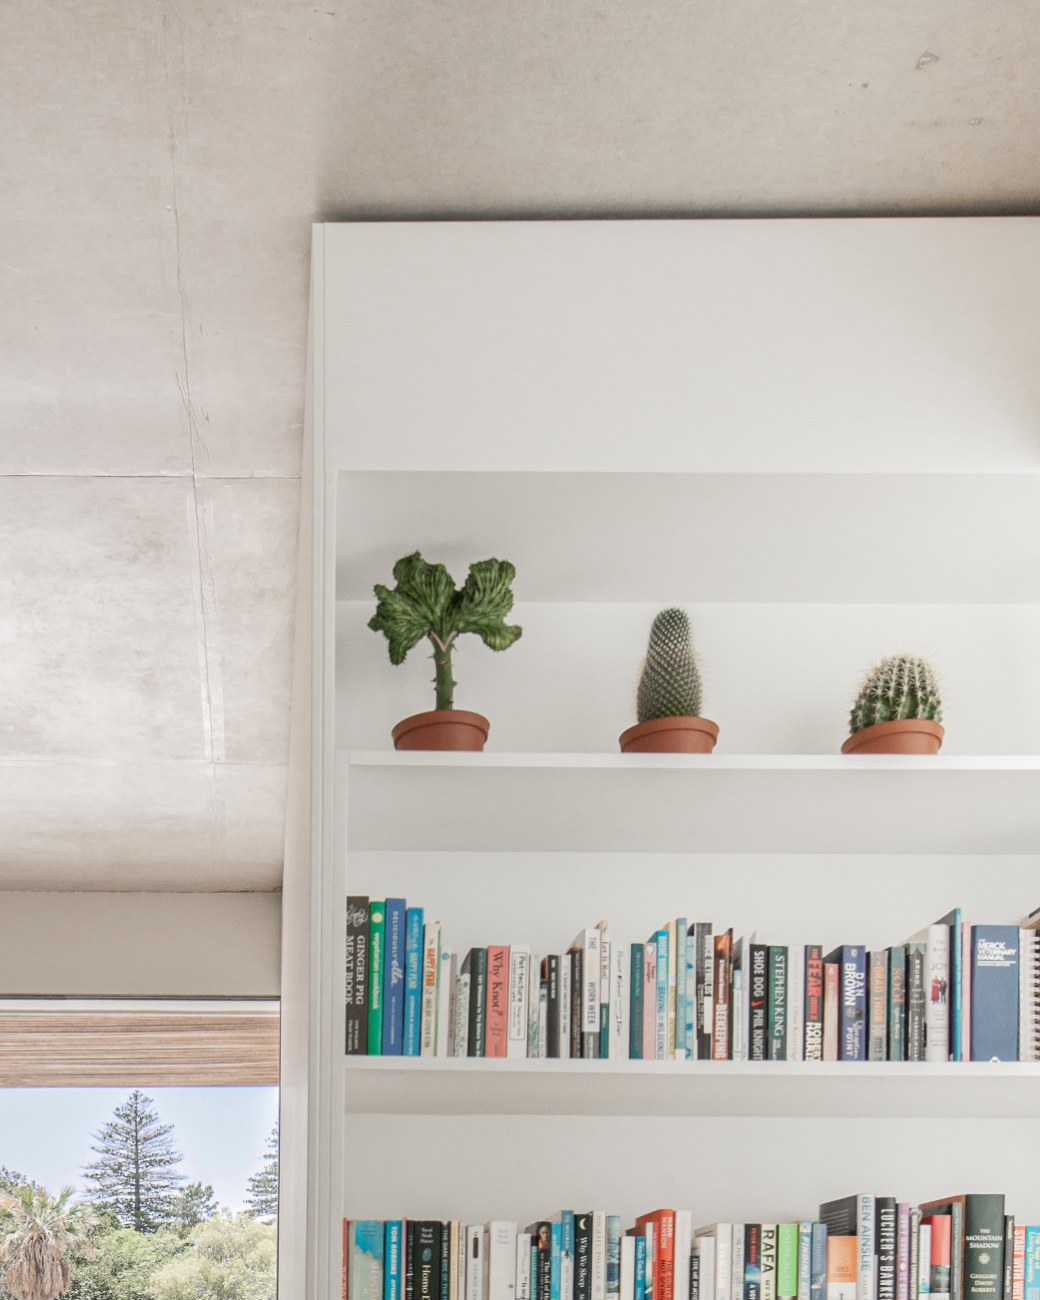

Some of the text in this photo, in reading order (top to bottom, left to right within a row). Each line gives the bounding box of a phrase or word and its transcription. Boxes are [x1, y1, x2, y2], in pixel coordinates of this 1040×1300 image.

[345, 936, 354, 1004] MEAT BOOK
[355, 935, 365, 1005] GINGER PIG
[372, 932, 380, 1010] vegetarian cookbook
[391, 959, 402, 987] ella
[427, 948, 435, 969] HAPPY
[517, 956, 525, 1003] Pet-tecture
[587, 937, 596, 1024] THE WORK WEEK
[753, 951, 765, 997] SHOE DOG
[808, 959, 821, 997] FEAR
[490, 951, 504, 1016] Why Knot?
[774, 955, 785, 1036] STEPHEN KING
[844, 963, 856, 1007] BROWN
[855, 973, 865, 997] DAN
[874, 966, 884, 1022] BRAD THOR
[657, 1022, 665, 1060] WILDERNESS
[716, 1004, 727, 1059] BEEKEEPING
[752, 1009, 763, 1060] PHIL KNIGHT
[846, 1027, 854, 1057] POINT
[762, 1229, 775, 1273] RAFA
[800, 1236, 809, 1278] FINDING
[861, 1196, 871, 1271] BEN AINSLIE
[880, 1209, 895, 1261] LUCIFER'S
[421, 1265, 431, 1293] Homo
[578, 1236, 587, 1288] Why We Sleep
[764, 1280, 770, 1291] MY
[862, 1275, 870, 1296] CLOSE
[1012, 1229, 1025, 1300] START WITH WHY
